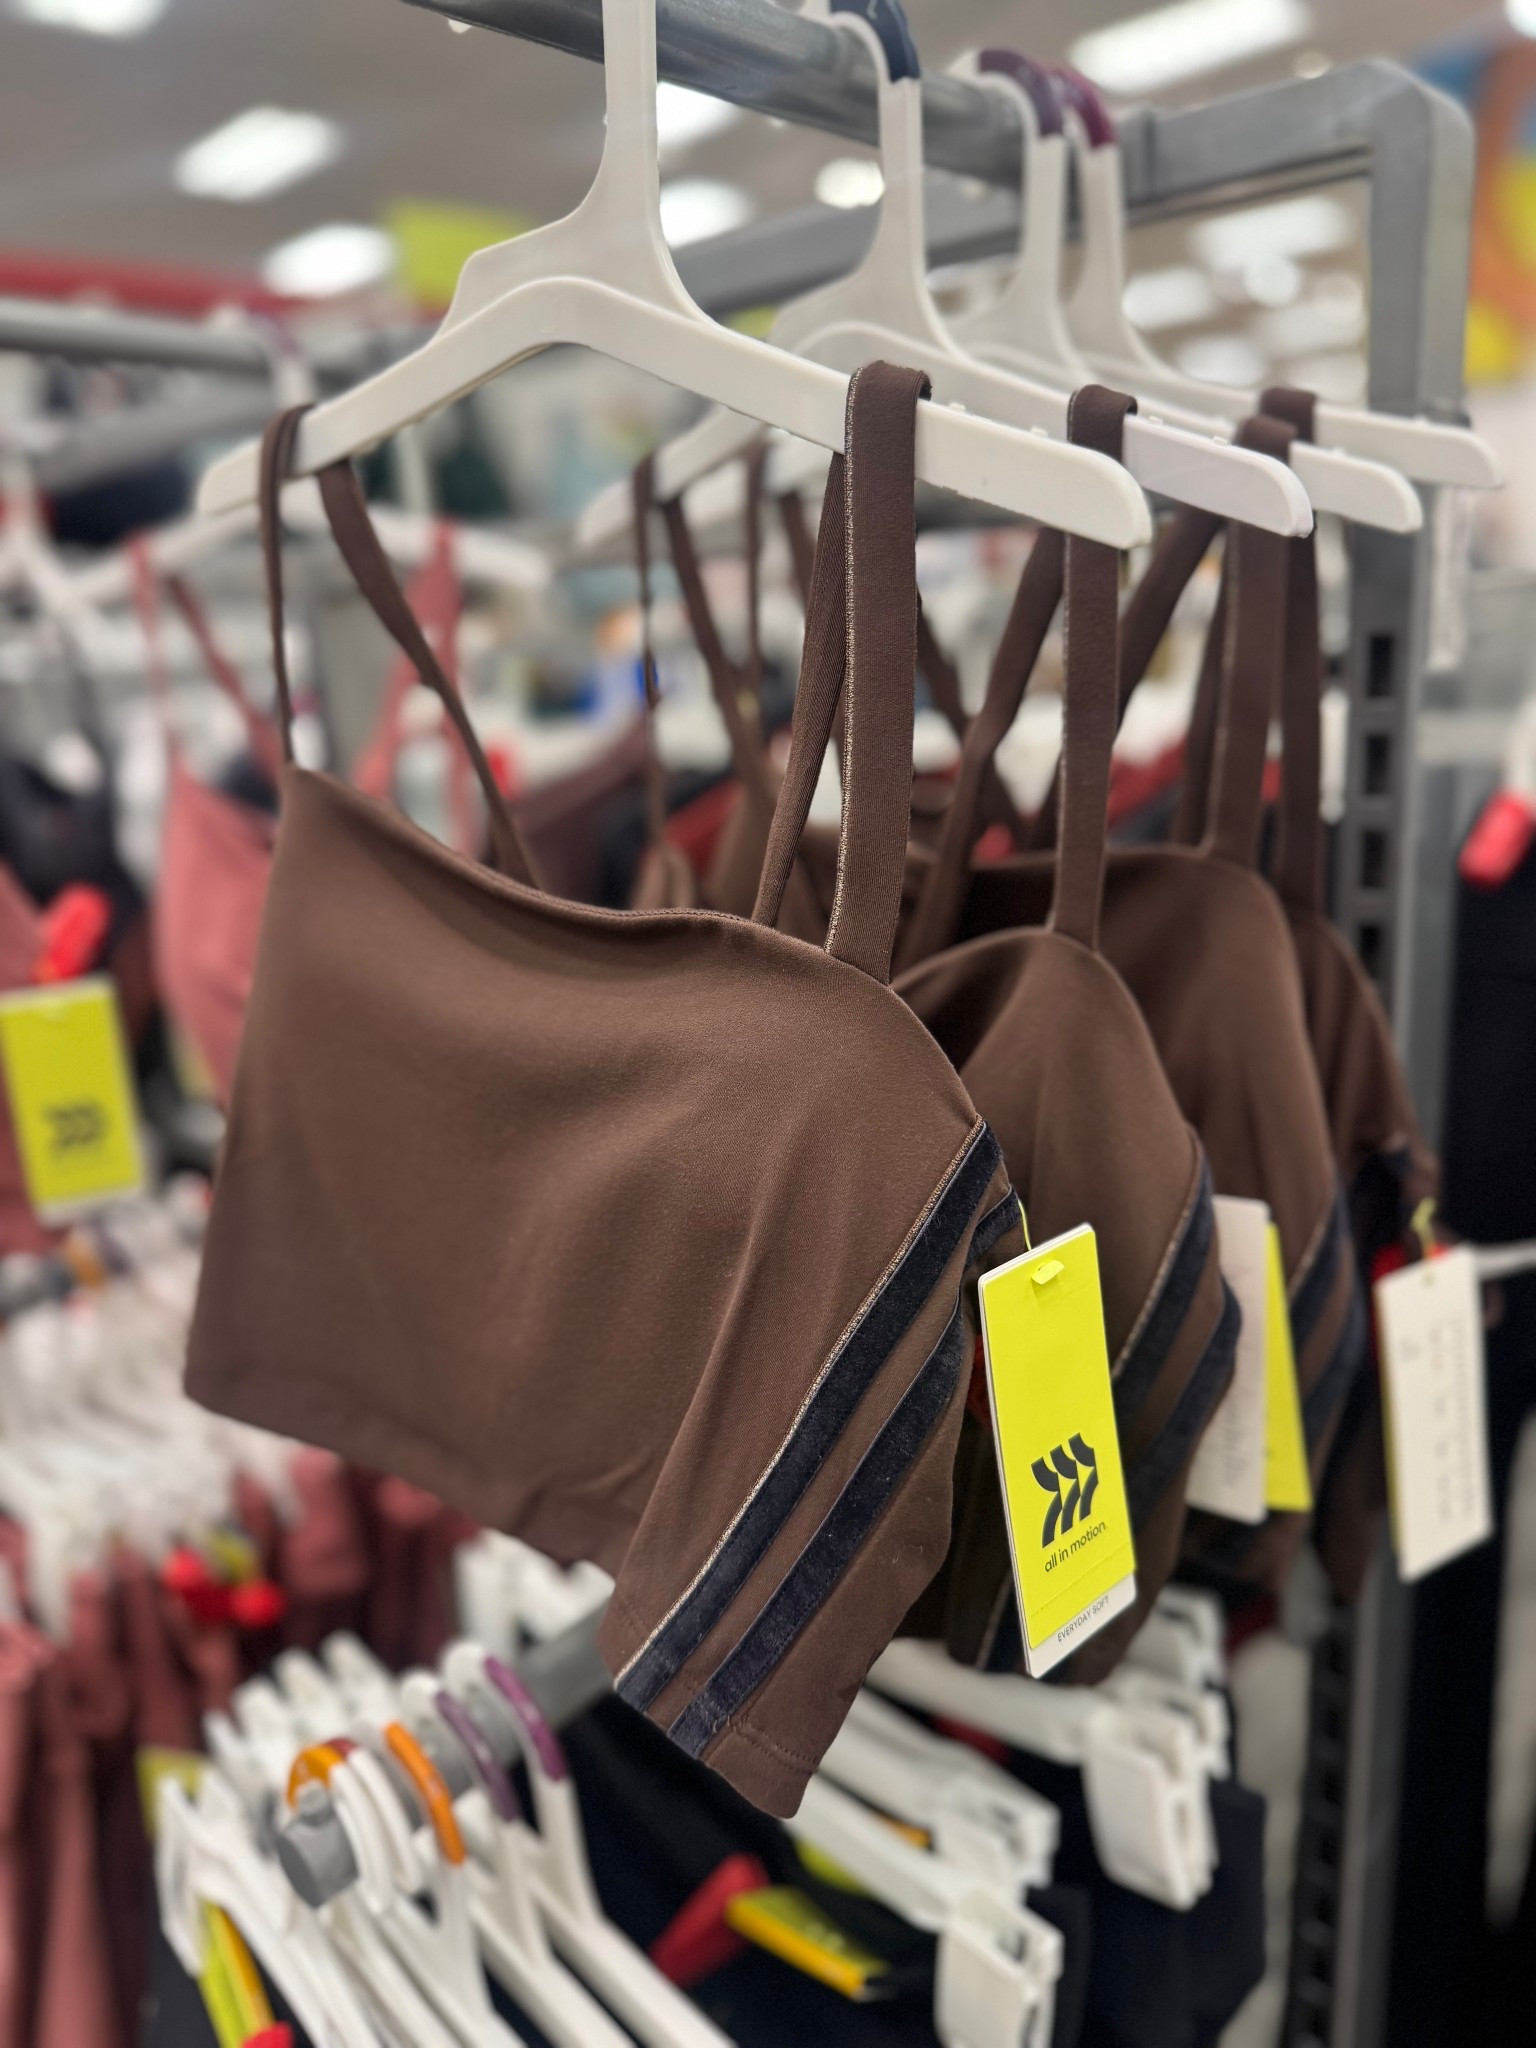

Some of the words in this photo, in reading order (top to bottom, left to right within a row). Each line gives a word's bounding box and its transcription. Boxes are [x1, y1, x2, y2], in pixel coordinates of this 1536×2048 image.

[1044, 1552, 1058, 1573] all
[1058, 1548, 1069, 1563] in
[1070, 1521, 1106, 1555] motion
[1057, 1609, 1092, 1642] EVERYDAY
[1092, 1595, 1109, 1615] SOFT
